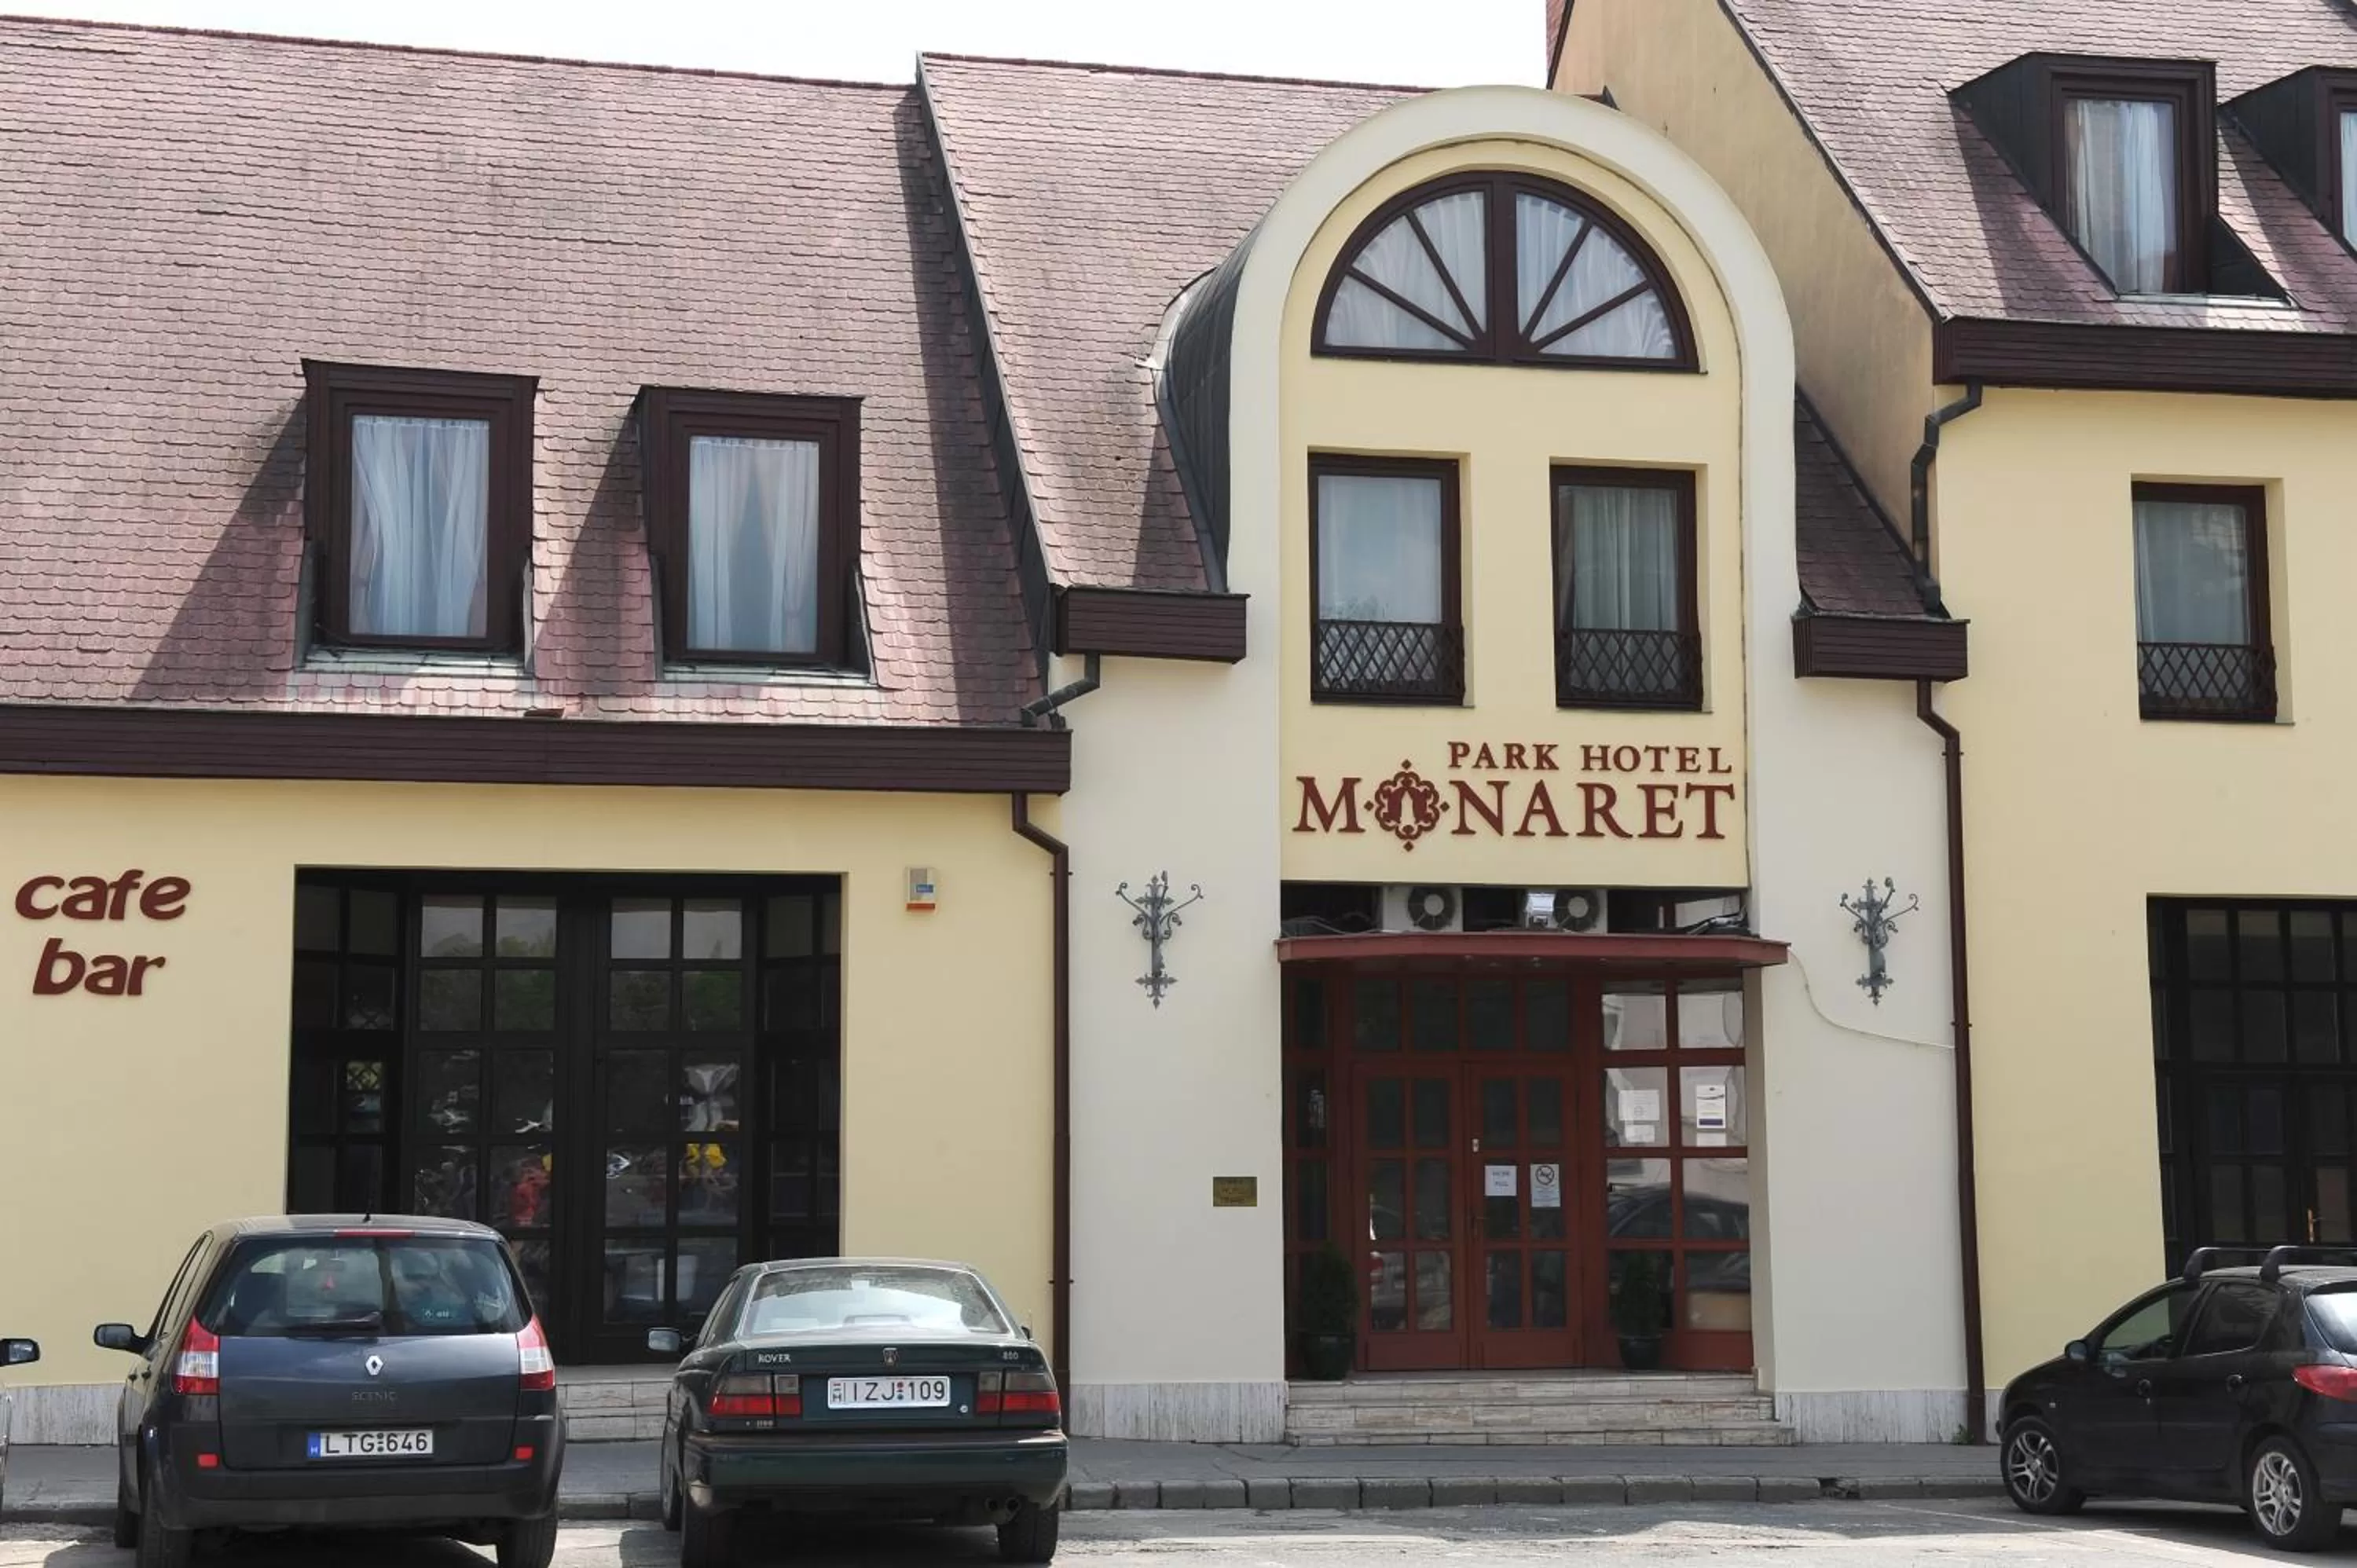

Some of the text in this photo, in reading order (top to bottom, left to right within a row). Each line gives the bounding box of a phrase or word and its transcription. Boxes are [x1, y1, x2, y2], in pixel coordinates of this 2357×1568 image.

[1447, 740, 1733, 775] PARK HOTEL
[15, 868, 191, 921] cafe
[32, 937, 167, 996] bar
[757, 1353, 792, 1364] ROVER
